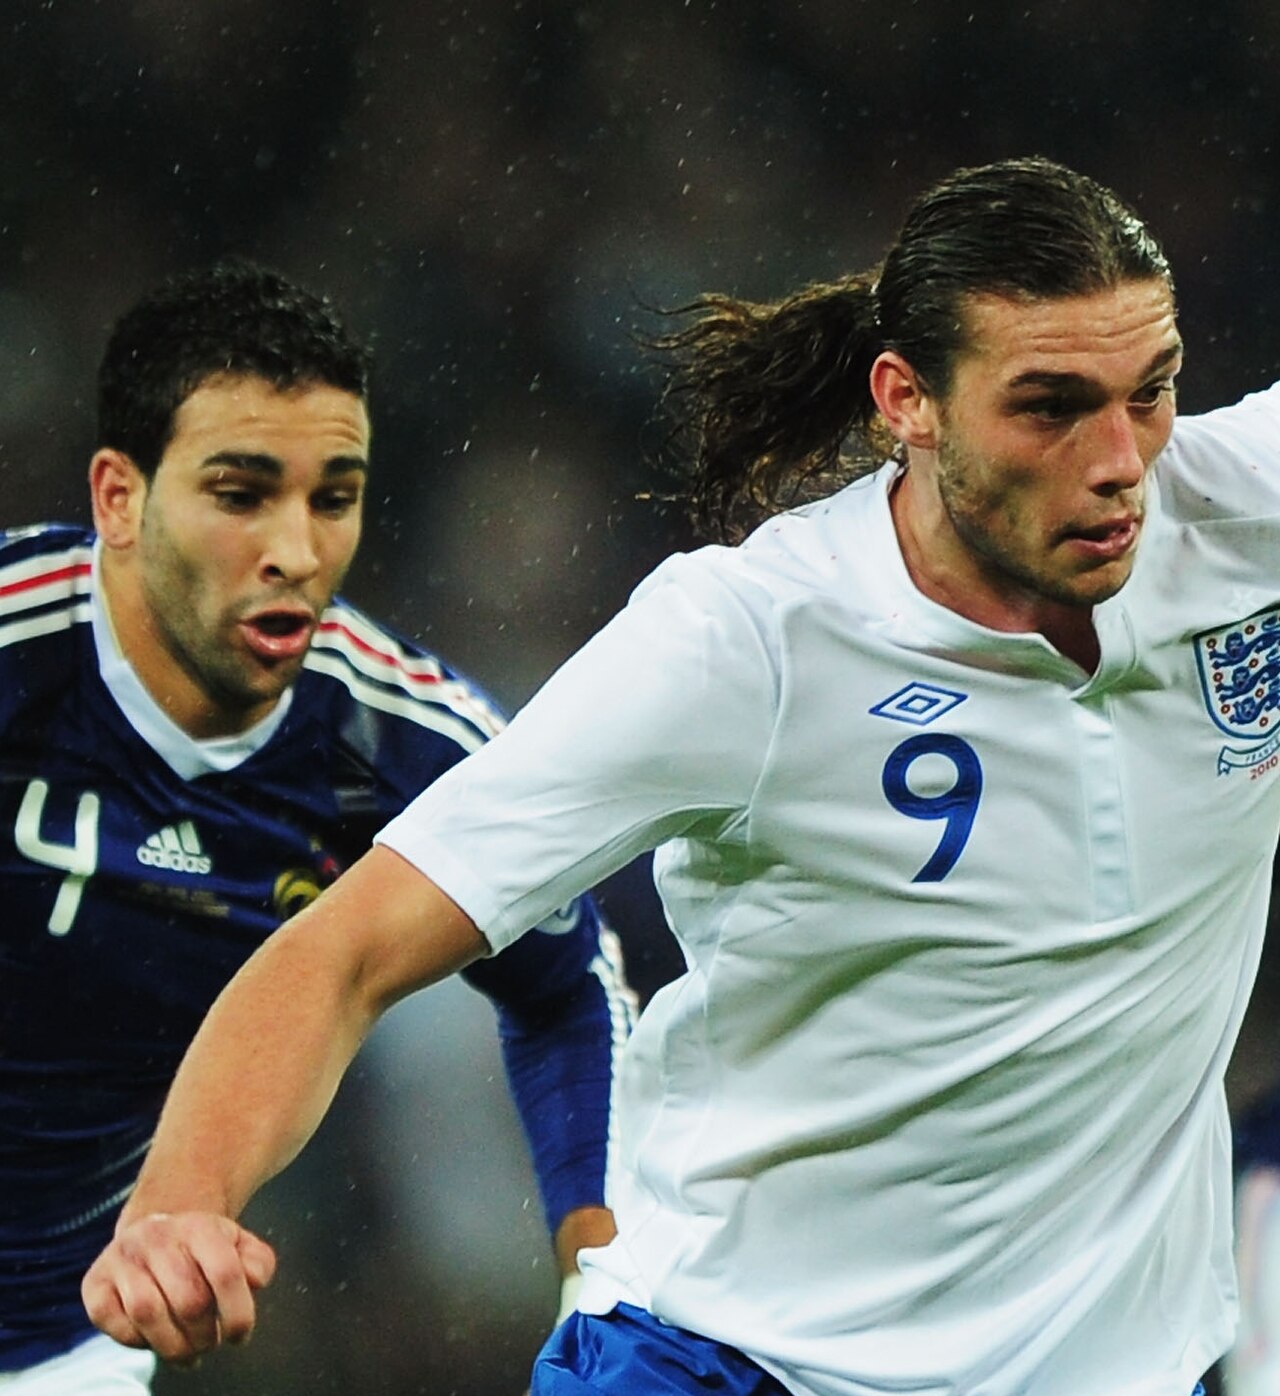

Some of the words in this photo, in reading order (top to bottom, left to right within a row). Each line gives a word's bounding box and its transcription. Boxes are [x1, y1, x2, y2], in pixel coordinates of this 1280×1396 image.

[882, 732, 983, 884] 9
[1249, 755, 1278, 780] 2010
[15, 778, 101, 937] 4
[137, 846, 212, 874] adidas
